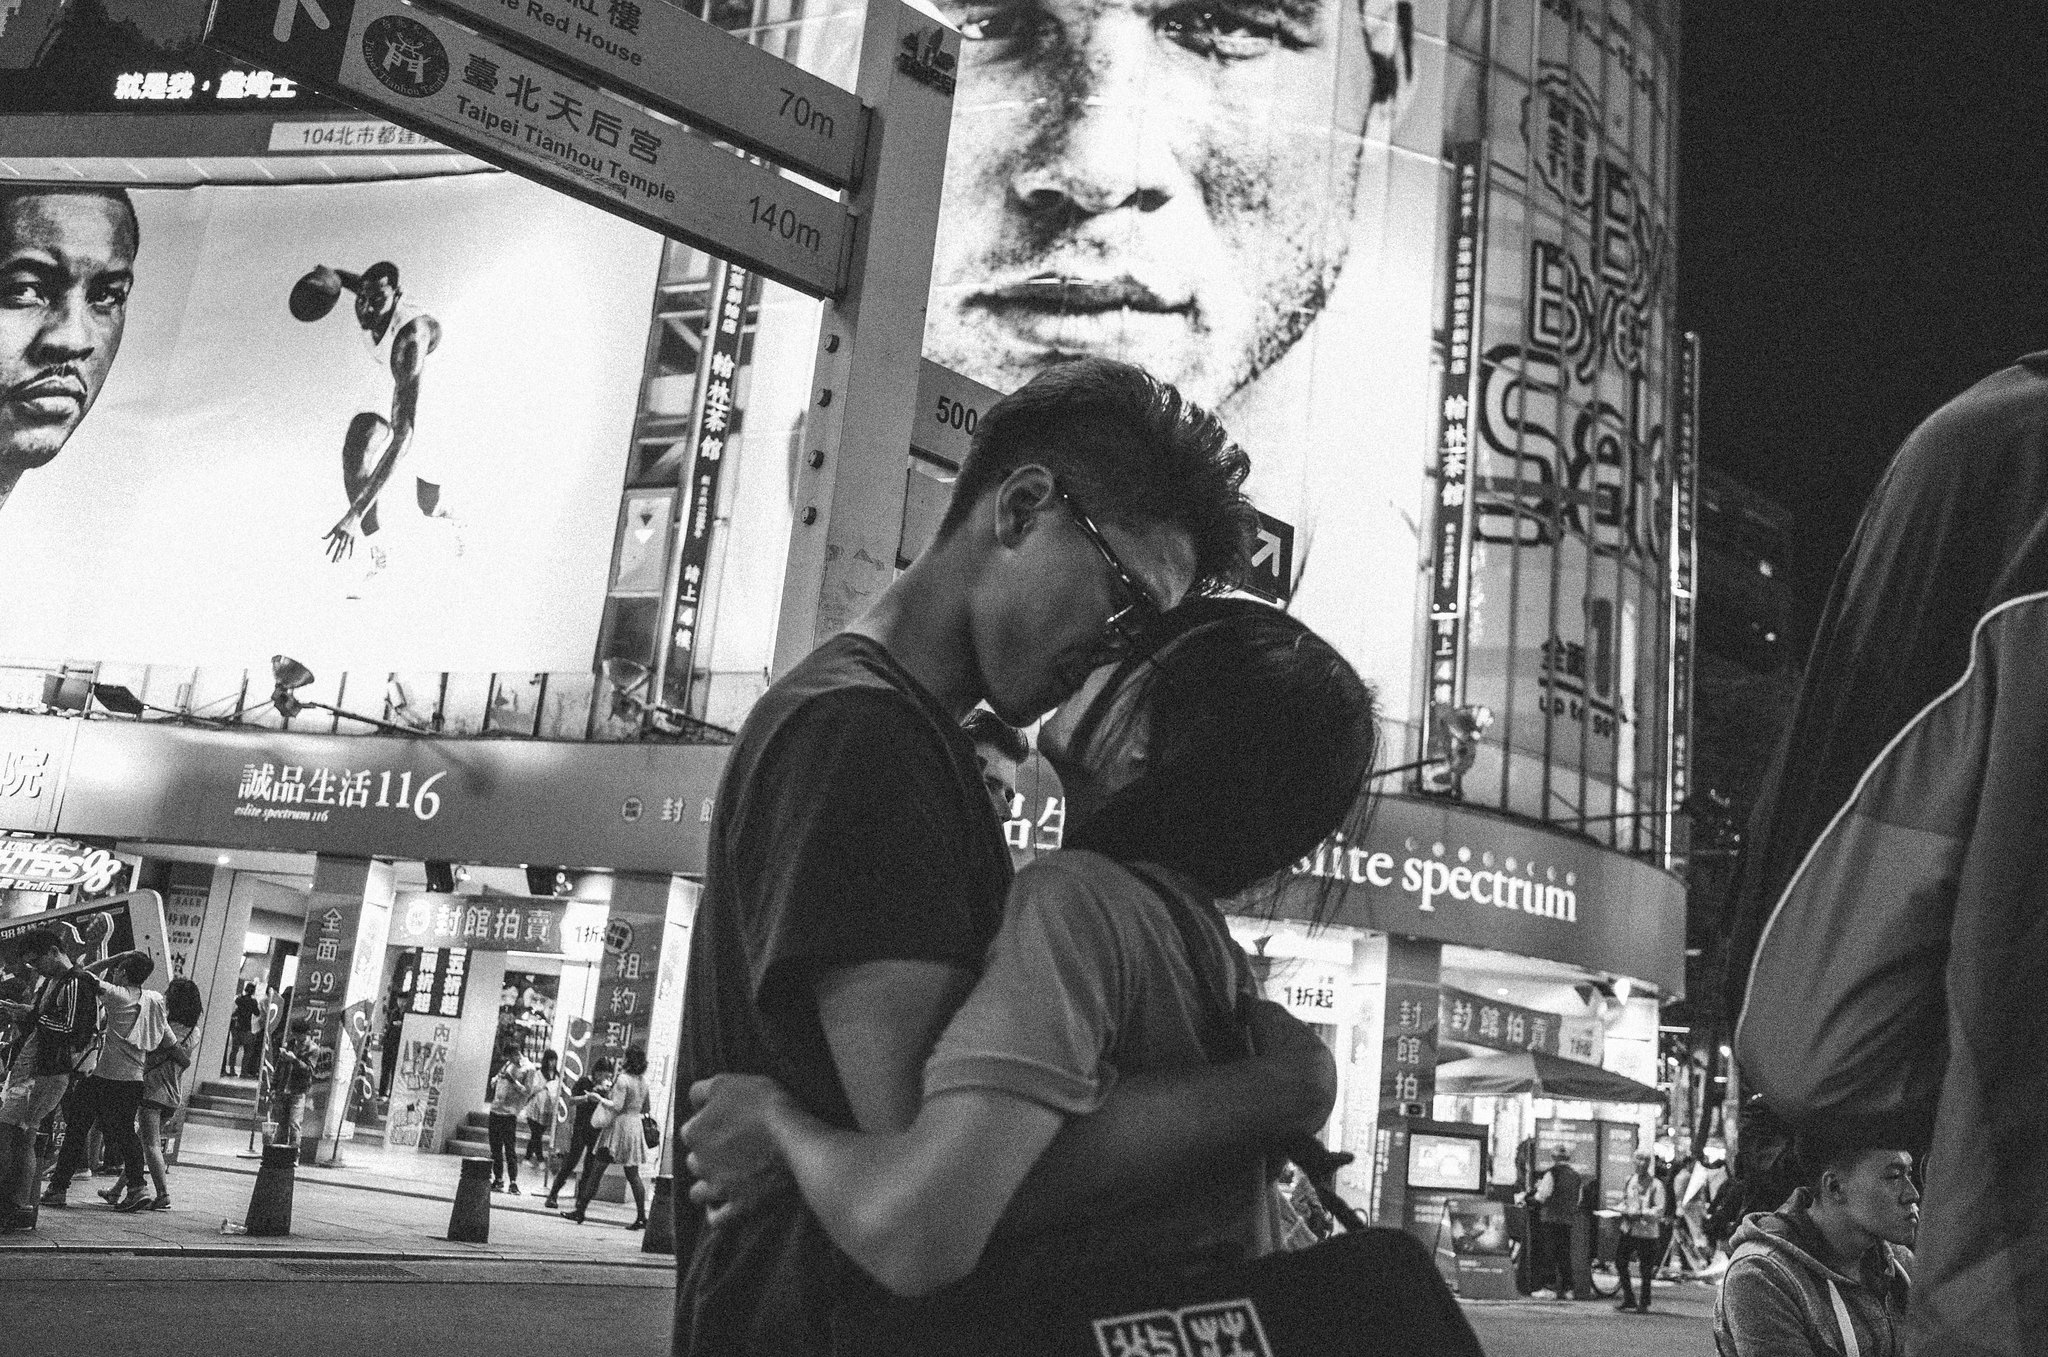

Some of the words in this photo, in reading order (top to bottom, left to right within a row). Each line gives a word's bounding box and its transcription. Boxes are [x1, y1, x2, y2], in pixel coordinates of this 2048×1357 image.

[526, 0, 570, 34] Red
[574, 22, 643, 67] House
[462, 53, 662, 165] 臺北天后宮
[779, 87, 834, 139] 70m
[457, 94, 519, 137] Taipei
[524, 124, 602, 171] Tianhou
[609, 160, 675, 203] Temple
[750, 195, 821, 251] 140m
[935, 395, 978, 436] 500
[238, 763, 371, 808] 誠品生活
[374, 770, 447, 820] 116
[1401, 857, 1577, 923] spectrum
[434, 906, 552, 943] 封館拍賣
[1284, 987, 1333, 1009] 1折起
